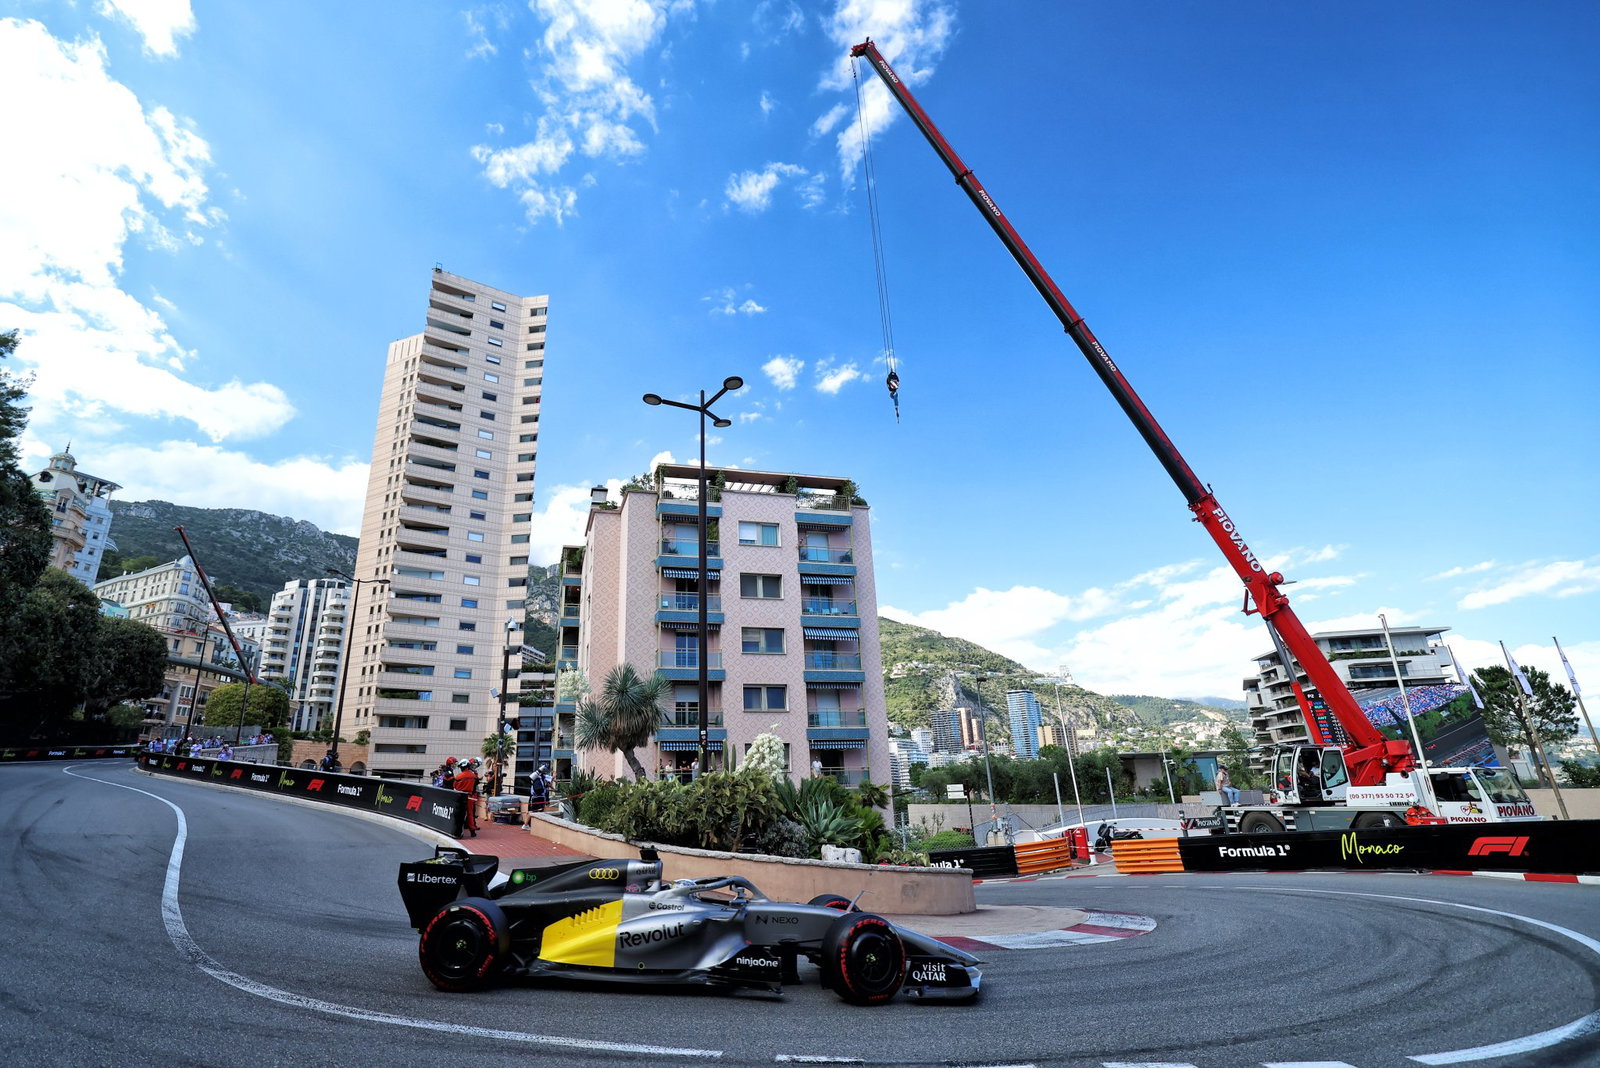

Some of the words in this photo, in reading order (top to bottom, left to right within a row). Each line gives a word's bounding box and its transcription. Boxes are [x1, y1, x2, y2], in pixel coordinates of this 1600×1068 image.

[879, 60, 899, 83] PIOVANO
[979, 190, 1000, 216] PIOVANO
[1092, 341, 1117, 372] PIOVANO
[1212, 508, 1262, 572] PIOVANO
[251, 773, 266, 782] Formula
[337, 784, 357, 796] Formula
[432, 803, 449, 818] Formula
[1497, 805, 1535, 816] PIOVANO
[1218, 846, 1276, 858] Formula
[1341, 831, 1404, 864] Monaco
[1467, 836, 1530, 856] F1
[417, 873, 457, 884] Libertex
[525, 873, 537, 882] bp
[656, 902, 684, 911] Castrol
[619, 922, 684, 948] Revolut
[736, 956, 778, 968] ninjaOne
[922, 962, 946, 972] visit
[912, 970, 946, 982] QATAR
